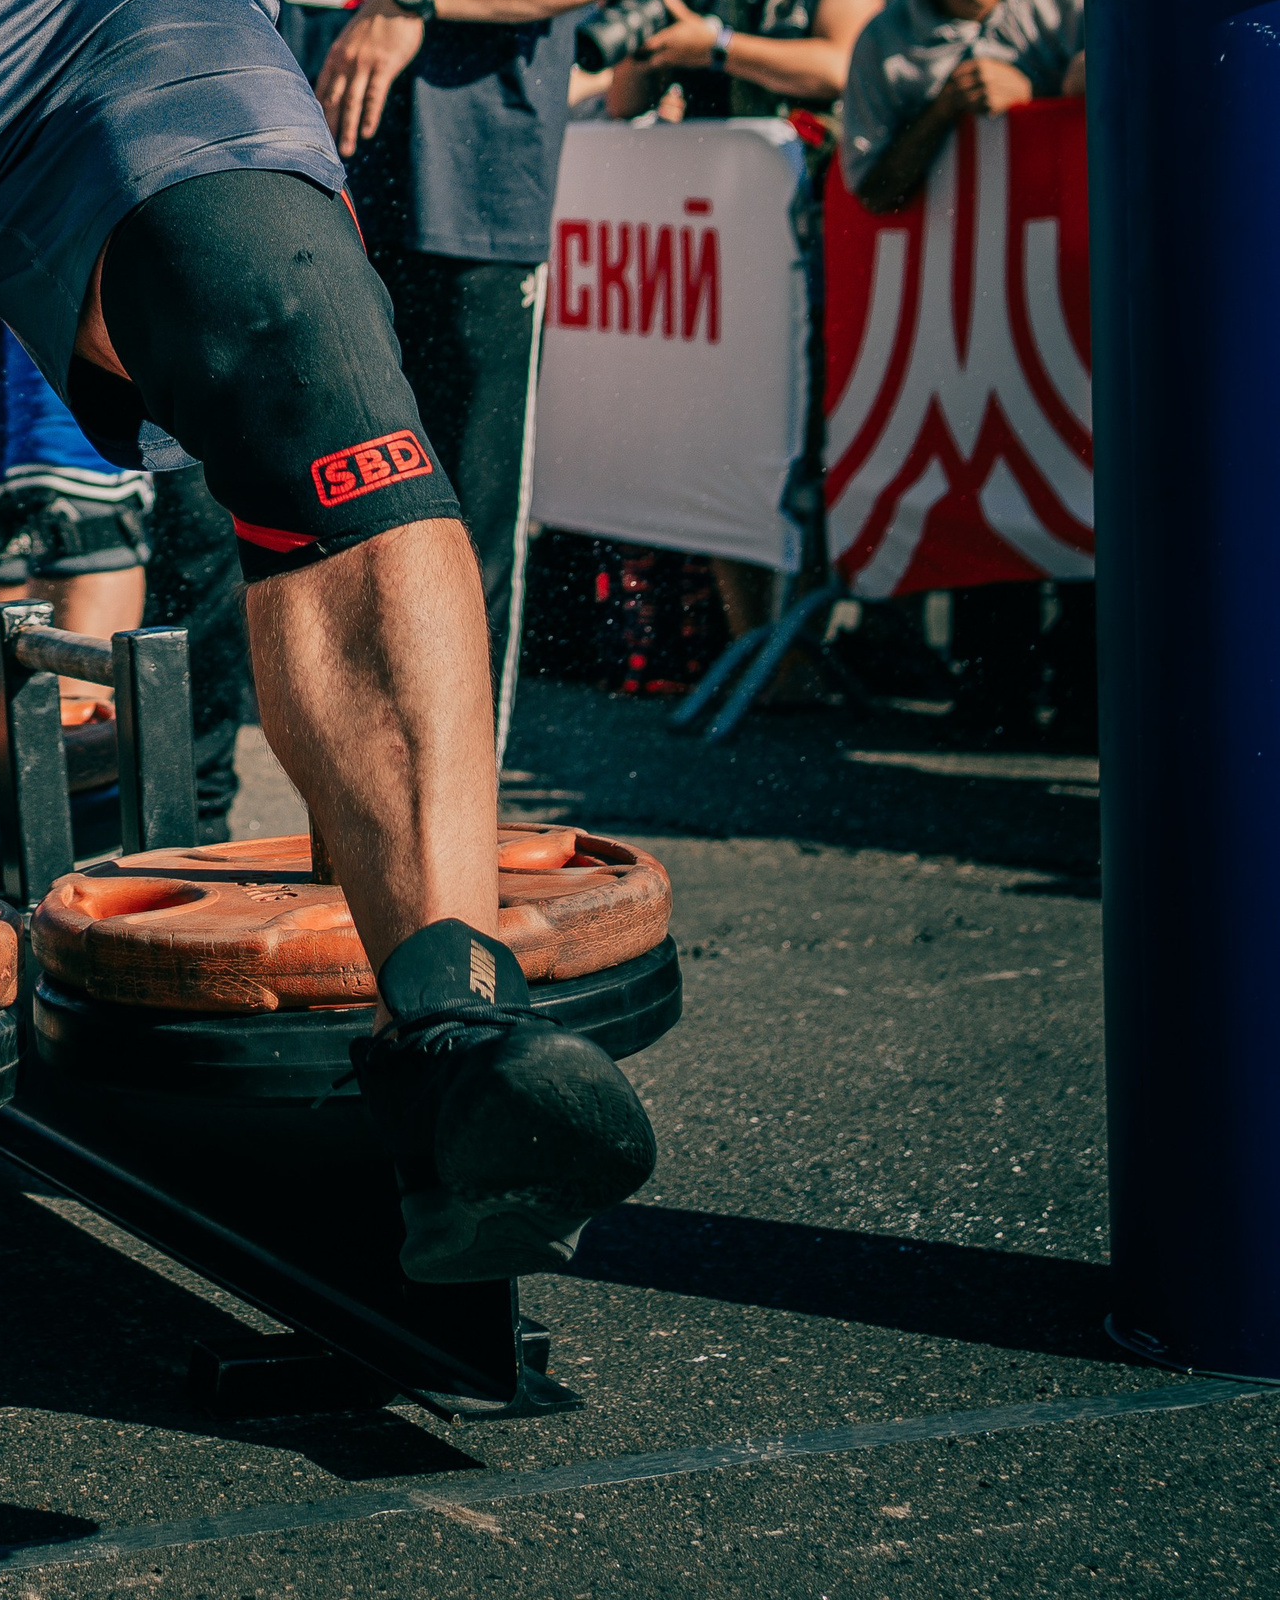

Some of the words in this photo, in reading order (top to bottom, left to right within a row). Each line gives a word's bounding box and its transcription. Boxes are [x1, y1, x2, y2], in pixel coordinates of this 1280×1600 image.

[545, 196, 722, 345] СКИЙ
[324, 438, 422, 497] SBD
[469, 937, 497, 1005] NIKE
